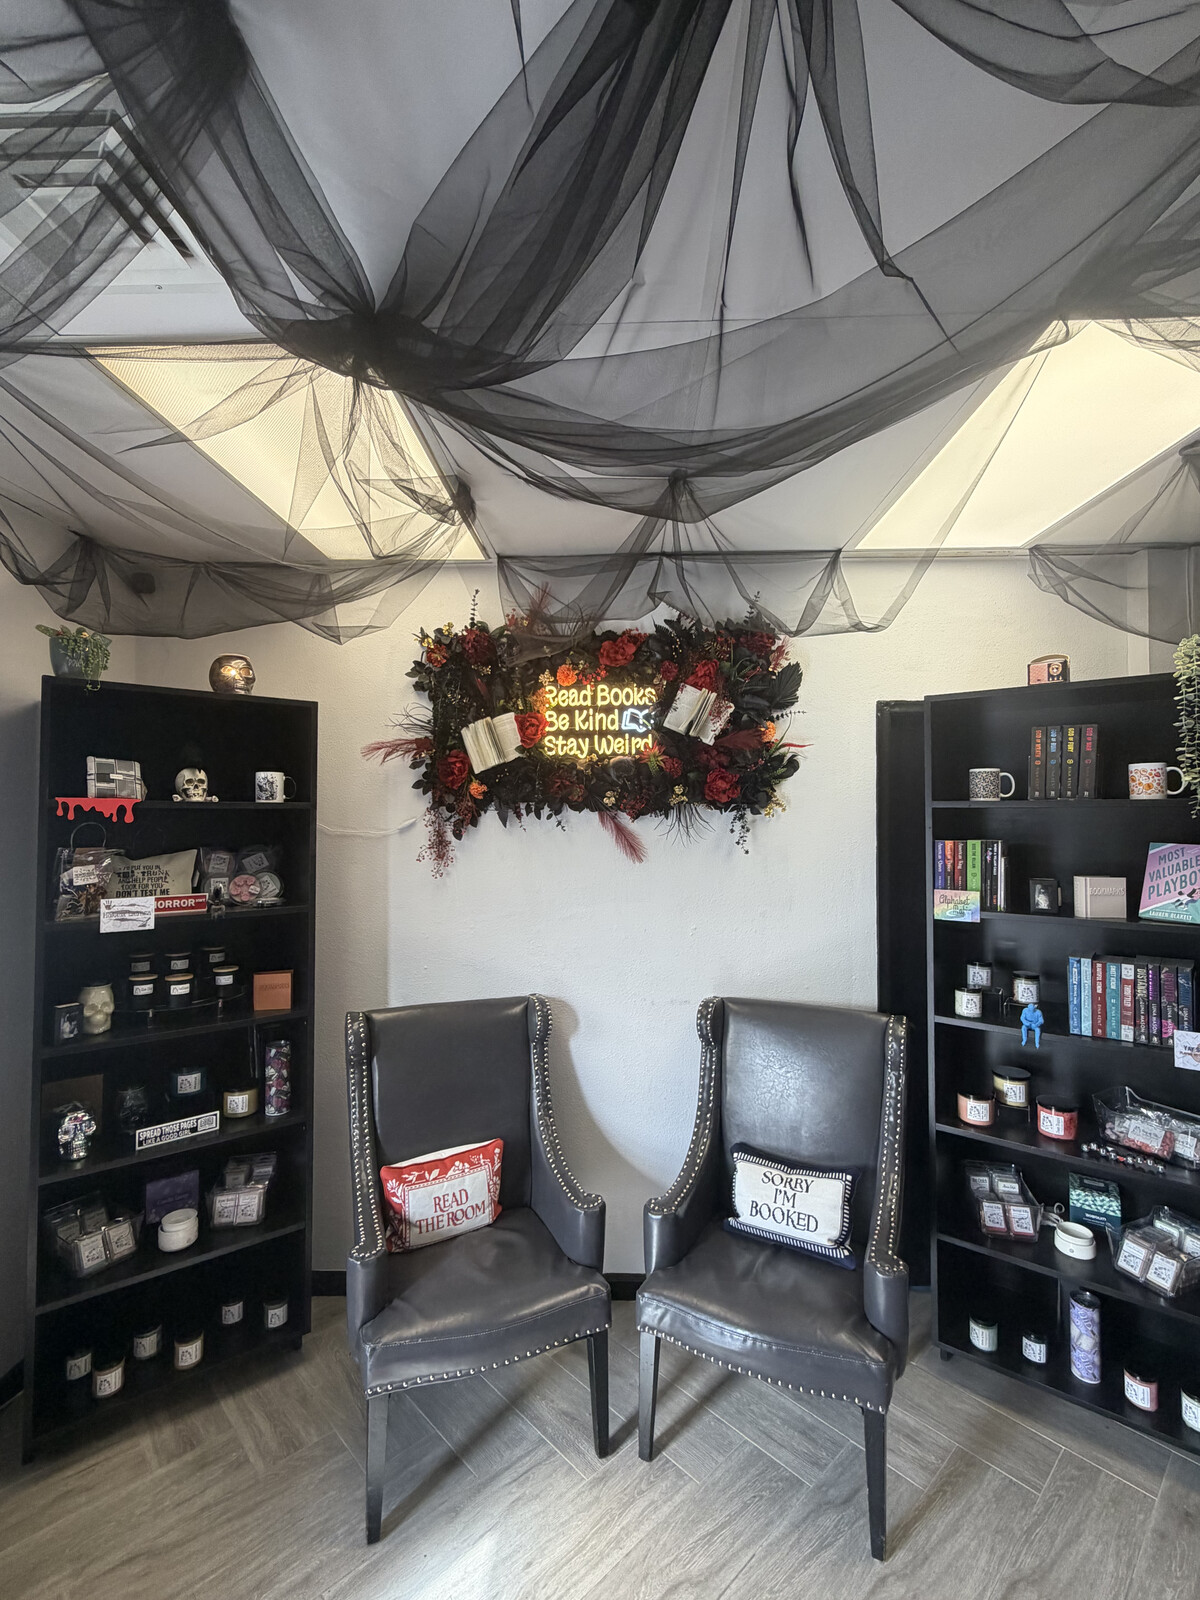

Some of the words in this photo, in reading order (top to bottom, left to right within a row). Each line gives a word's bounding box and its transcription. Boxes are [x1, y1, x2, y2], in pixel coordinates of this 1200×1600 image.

[545, 684, 592, 707] Read
[596, 683, 656, 706] Books
[545, 710, 569, 731] Be
[575, 708, 619, 731] Kind
[544, 735, 589, 758] Stay
[594, 733, 652, 755] Weird
[1158, 847, 1185, 865] MOST
[147, 875, 169, 883] PEOPLE
[1149, 855, 1200, 882] VALUABLE
[116, 890, 138, 898] DON'T
[140, 889, 157, 897] TEST
[1089, 887, 1125, 896] BOOKMARKS
[1148, 869, 1200, 900] PLAYBO
[939, 894, 970, 909] Alphabet
[139, 1129, 162, 1141] SPREAD
[162, 1123, 180, 1135] THOSE
[180, 1119, 197, 1131] PAGES
[142, 1138, 156, 1146] LIKE
[161, 1133, 178, 1141] GOOD
[1081, 1142, 1116, 1159] SMUT
[1127, 1157, 1164, 1173] SLUT
[761, 1170, 814, 1193] SORRY
[433, 1189, 468, 1213] READ
[773, 1188, 796, 1208] I'M
[415, 1214, 445, 1234] THE
[446, 1200, 486, 1226] ROOM
[749, 1200, 818, 1232] BOOKED
